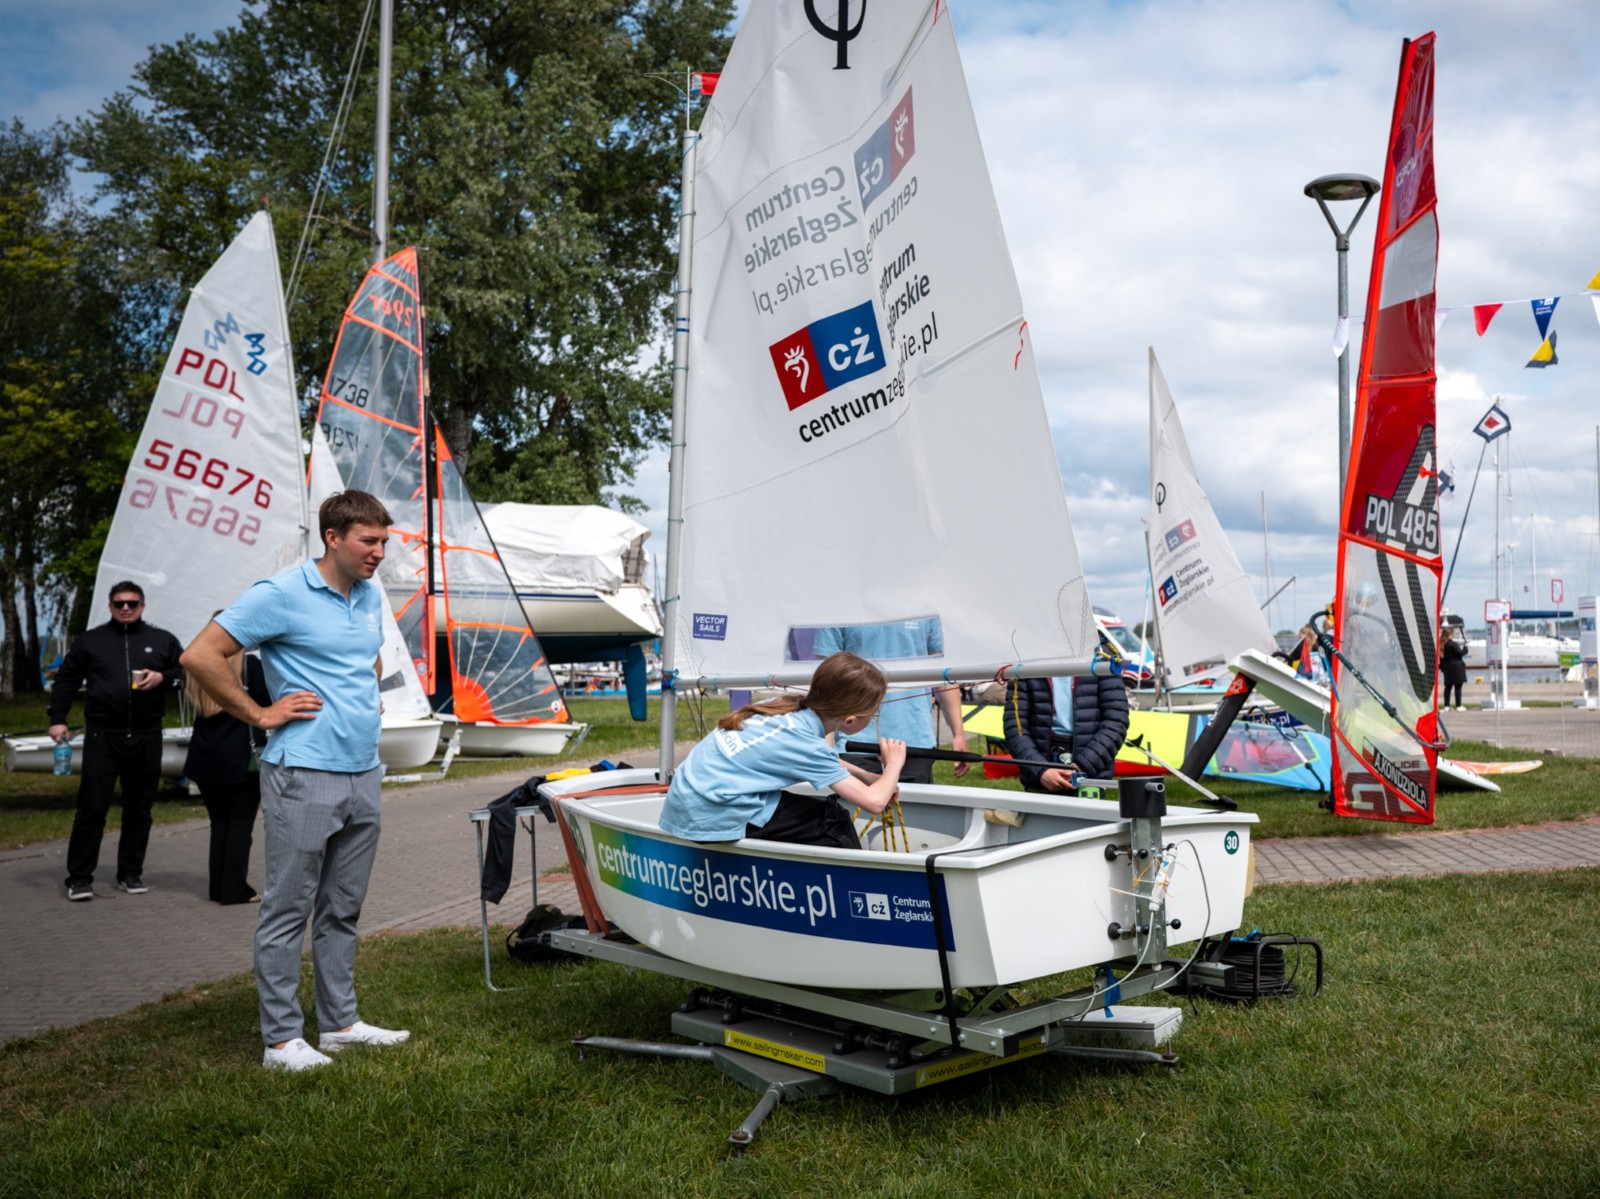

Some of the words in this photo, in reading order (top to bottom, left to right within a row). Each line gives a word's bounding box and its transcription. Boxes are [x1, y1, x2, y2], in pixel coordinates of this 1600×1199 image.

[828, 326, 875, 372] cż
[175, 347, 245, 401] POL
[328, 375, 369, 408] 1738
[144, 438, 273, 510] 56676
[1365, 495, 1397, 538] POL
[1400, 506, 1438, 550] 485
[695, 615, 726, 625] VECTOR
[699, 624, 720, 632] SAILS
[1226, 835, 1238, 851] 30
[598, 842, 837, 926] centrumzeglarskie.pl
[892, 895, 931, 908] Centrum
[894, 906, 934, 923] Żeglarski
[733, 1036, 824, 1069] www.sailingmaker.com
